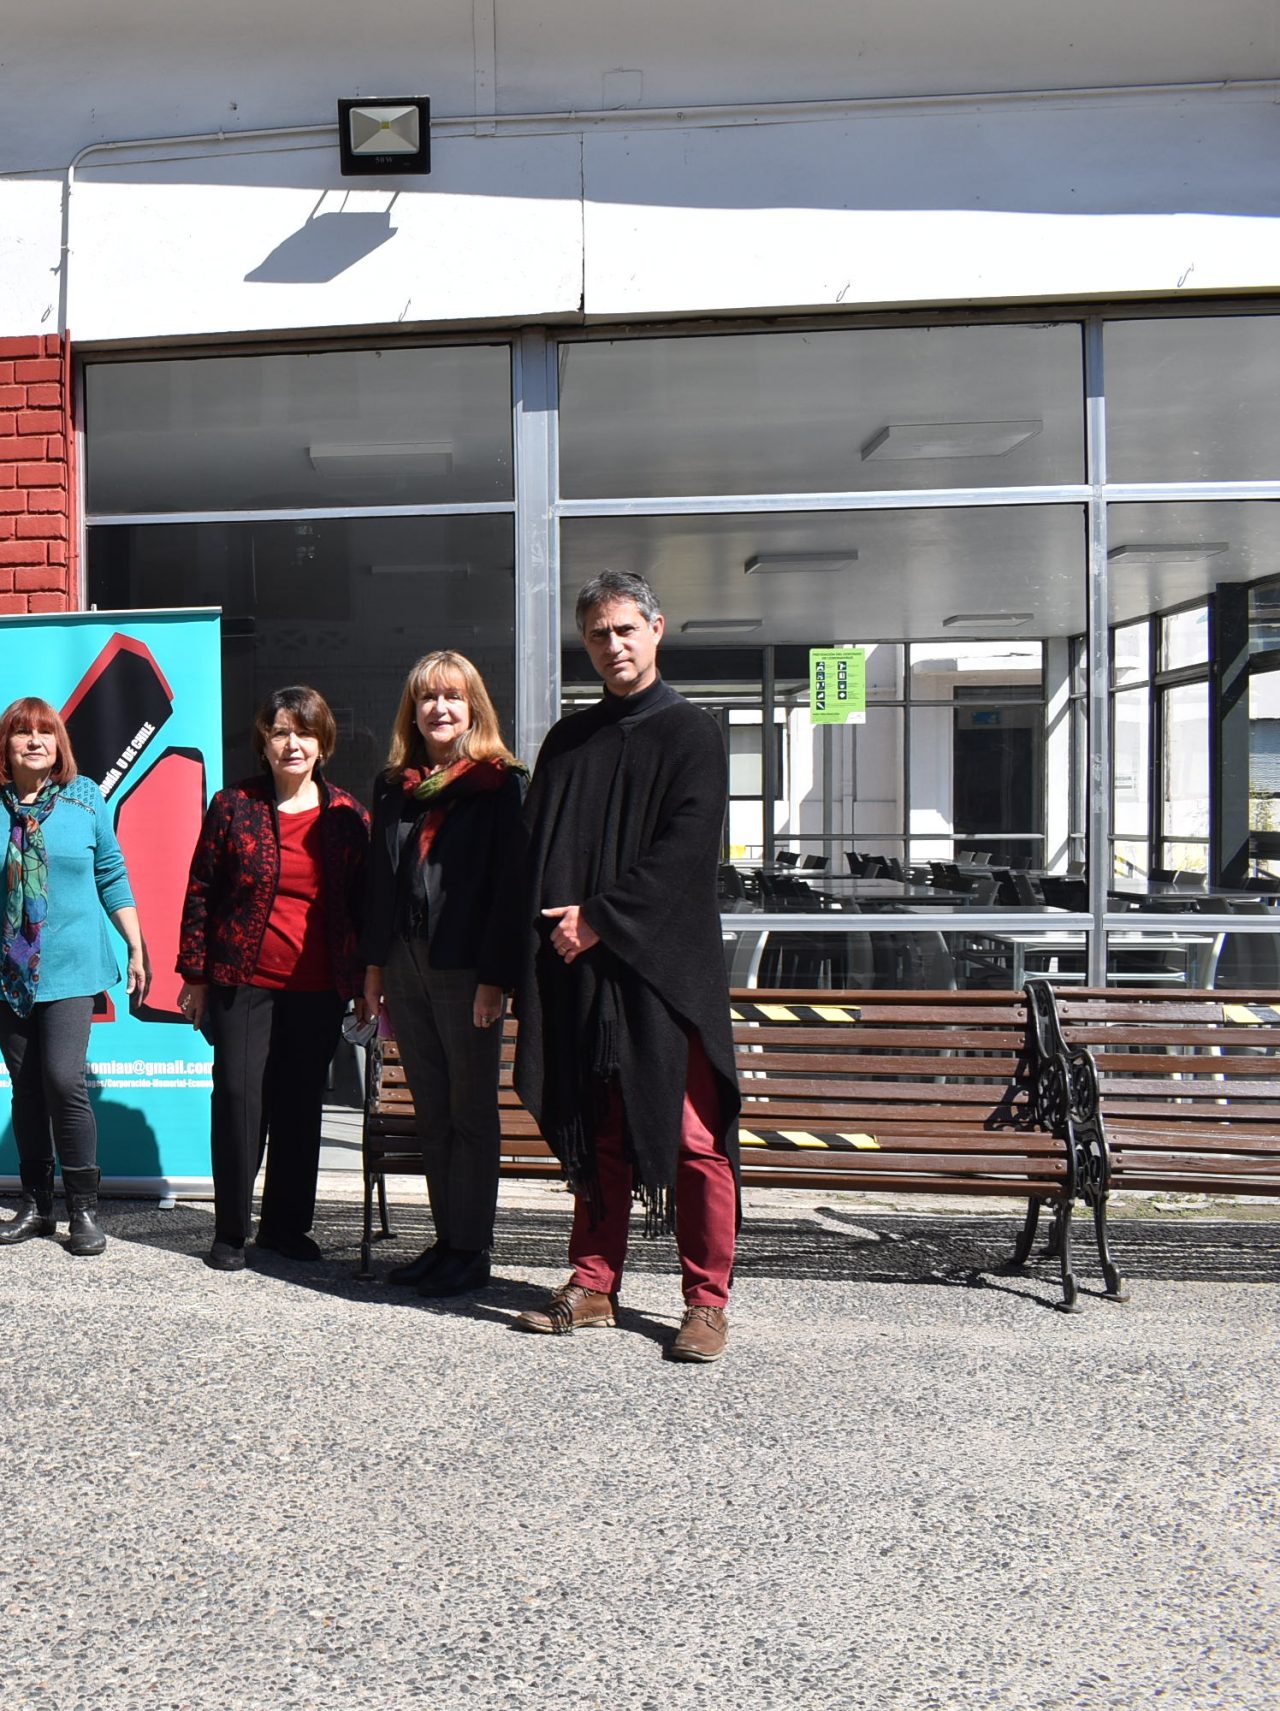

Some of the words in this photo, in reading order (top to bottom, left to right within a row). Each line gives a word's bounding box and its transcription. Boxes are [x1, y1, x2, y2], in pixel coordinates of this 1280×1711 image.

[130, 721, 156, 750] CHILE
[121, 745, 138, 763] DE
[115, 757, 129, 770] U
